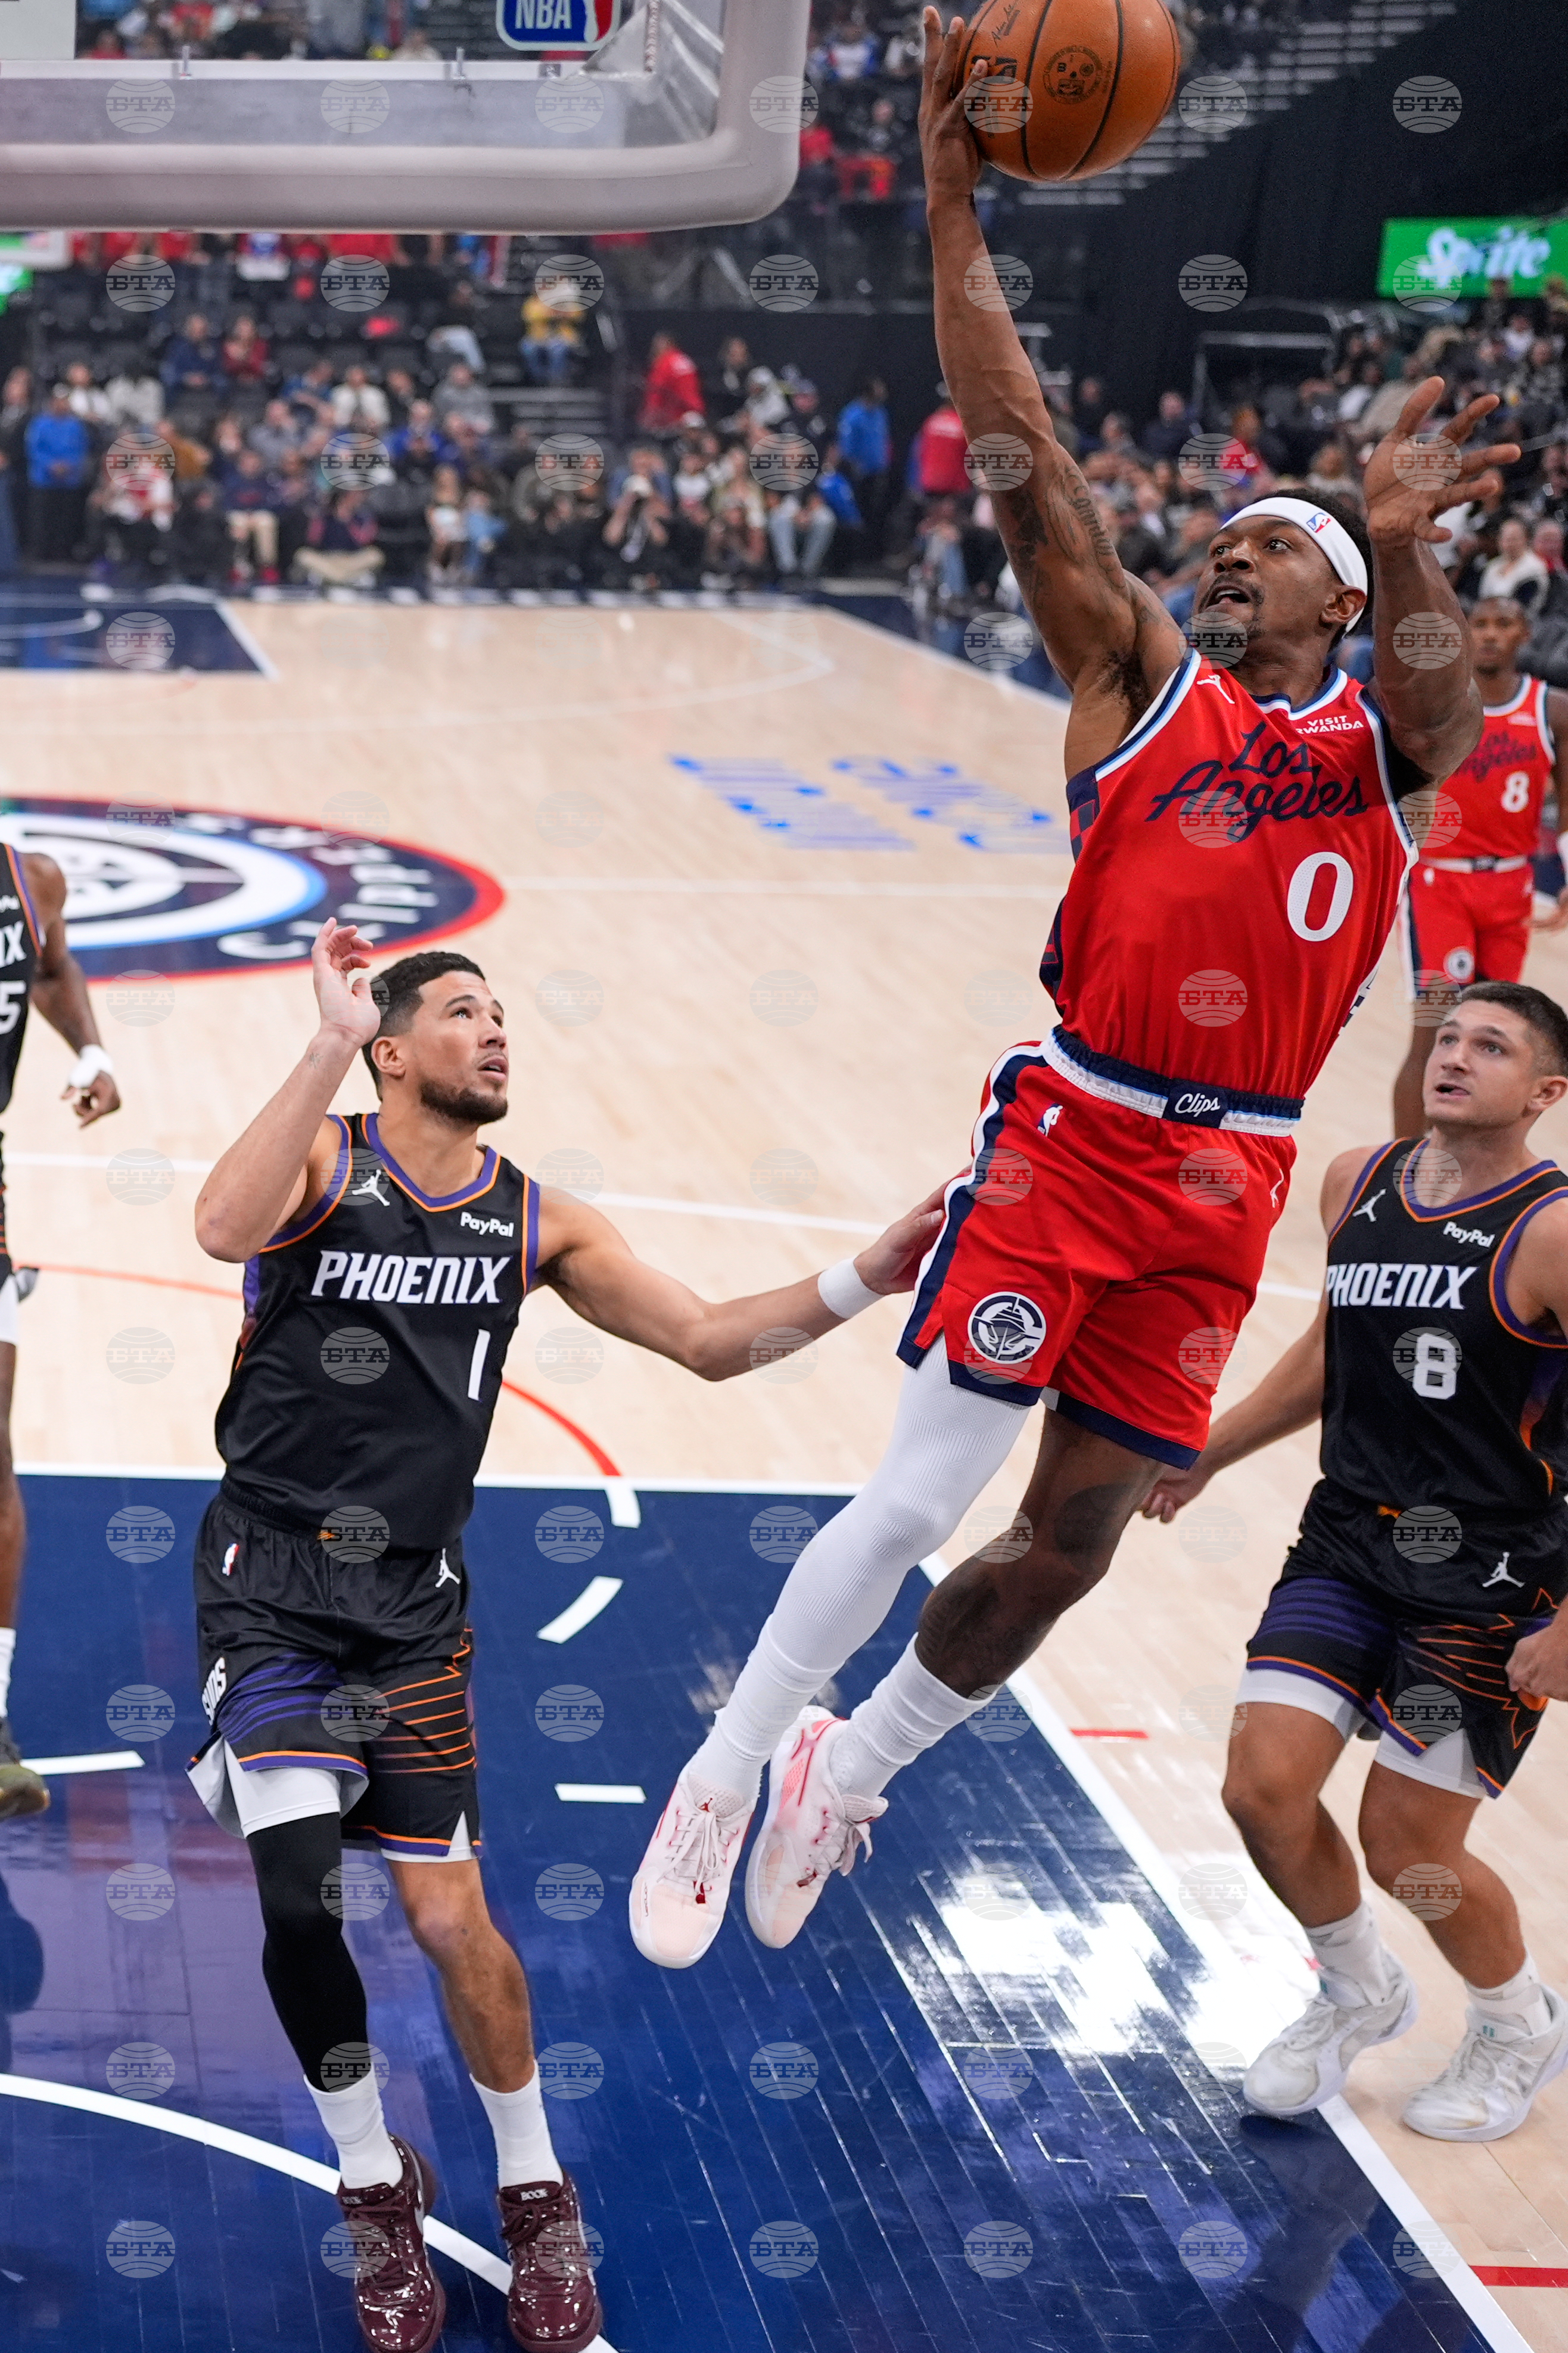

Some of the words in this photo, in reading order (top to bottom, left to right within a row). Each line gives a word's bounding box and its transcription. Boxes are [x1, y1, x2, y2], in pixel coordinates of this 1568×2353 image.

[515, 0, 572, 29] NBA
[1307, 715, 1347, 727] VISIT
[1228, 721, 1315, 778] Los
[1144, 760, 1370, 843] Angeles
[1501, 770, 1530, 813] 8
[1287, 851, 1354, 942] 0
[1174, 1093, 1221, 1117] Clips
[461, 1211, 514, 1238] PayPal
[1443, 1221, 1495, 1248] PayPal
[311, 1250, 511, 1304] PHOENIX
[1326, 1263, 1479, 1310] PHOENIX
[468, 1329, 491, 1401] 1
[1413, 1332, 1457, 1400] 8
[520, 2189, 548, 2201] BOOK
